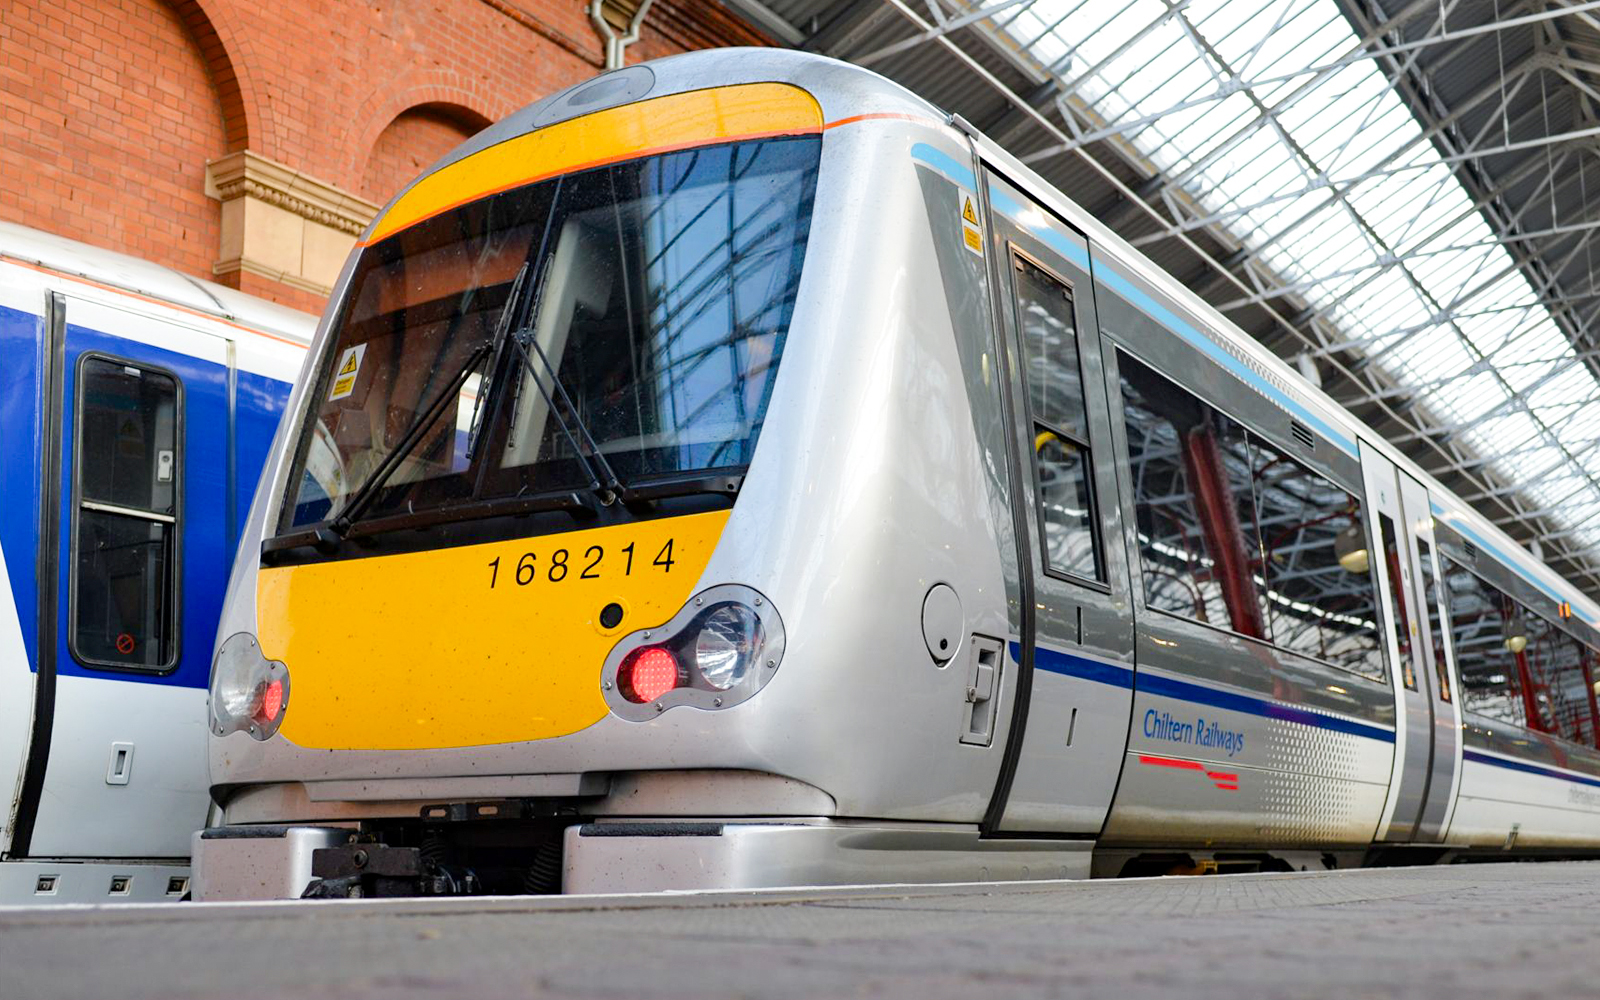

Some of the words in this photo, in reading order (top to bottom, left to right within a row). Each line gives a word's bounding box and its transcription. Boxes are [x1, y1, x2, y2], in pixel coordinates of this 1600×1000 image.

[488, 538, 675, 589] 168214
[1143, 708, 1193, 744] Chiltern
[1195, 718, 1243, 757] Railways
